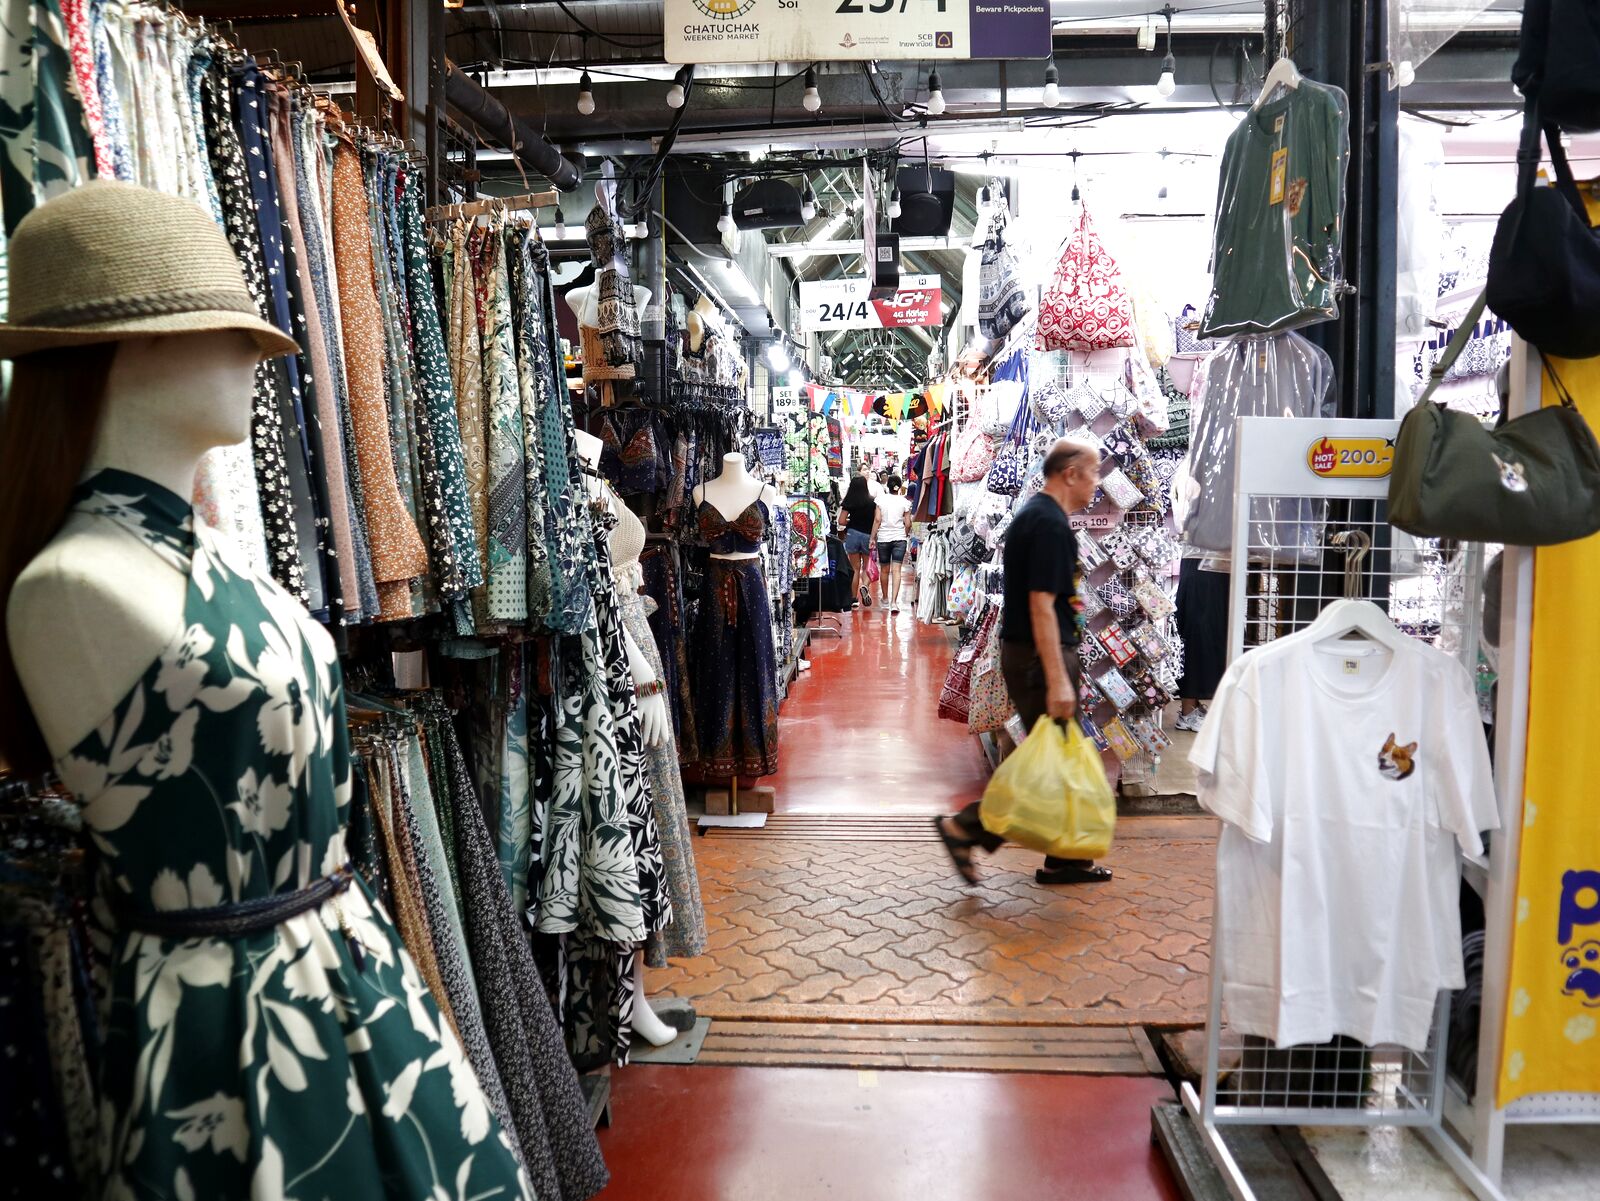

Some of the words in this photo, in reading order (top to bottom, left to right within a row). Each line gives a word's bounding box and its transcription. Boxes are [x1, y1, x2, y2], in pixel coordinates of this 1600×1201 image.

[976, 5, 1002, 13] Beware
[1003, 5, 1045, 14] Pickpockets
[683, 23, 760, 34] CHATUCHAK
[842, 283, 856, 293] 16
[819, 301, 869, 322] 24/4
[779, 390, 792, 398] SET
[1315, 454, 1334, 462] HOT
[1340, 449, 1390, 464] 200.-
[1314, 462, 1333, 470] SALE
[1071, 520, 1088, 528] pcs
[1090, 518, 1109, 527] 100
